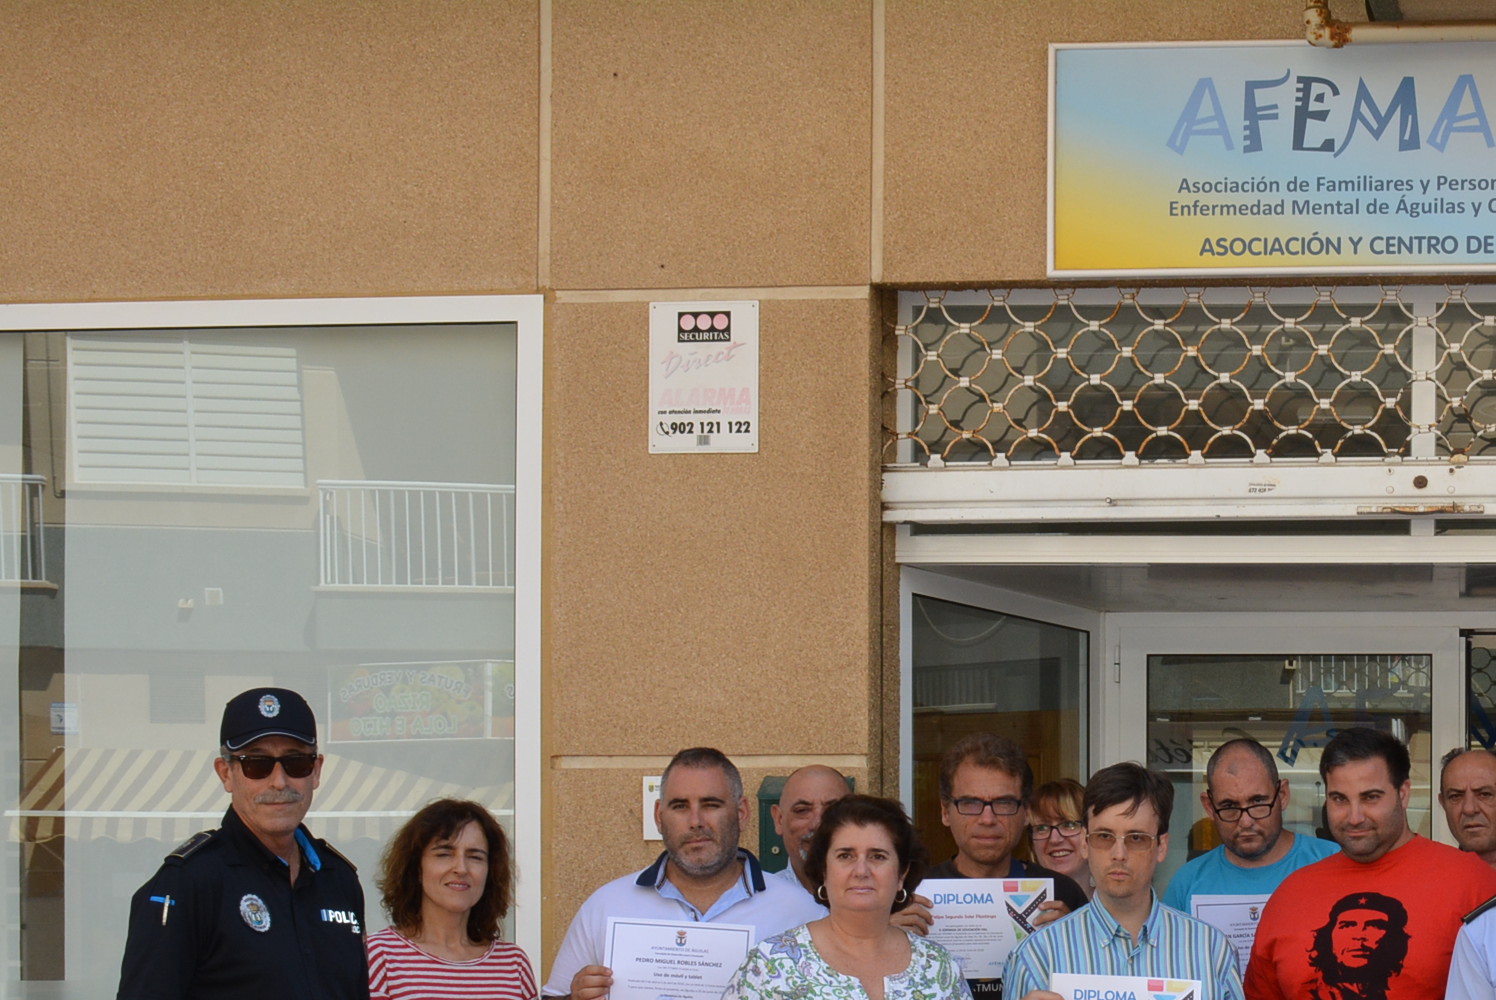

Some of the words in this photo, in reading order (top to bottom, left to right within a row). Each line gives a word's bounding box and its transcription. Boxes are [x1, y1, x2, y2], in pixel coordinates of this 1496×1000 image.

[1178, 176, 1280, 194] Asociación
[1287, 176, 1310, 193] de
[1317, 175, 1414, 193] Familiares
[1420, 179, 1431, 195] y
[1169, 199, 1285, 218] Enfermedad
[1292, 199, 1360, 215] Mental
[1366, 198, 1390, 215] de
[1396, 195, 1466, 218] Águilas
[1471, 202, 1482, 218] y
[1199, 231, 1342, 257] ASOCIACIÓN
[1349, 236, 1363, 255] Y
[1369, 235, 1459, 255] CENTRO
[1466, 235, 1495, 254] DE
[680, 332, 729, 340] SECURITAS
[657, 388, 750, 406] ALARMA
[671, 422, 694, 434] 902
[700, 421, 720, 434] 121
[728, 421, 750, 434] 122
[933, 893, 995, 905] DIPLOMA
